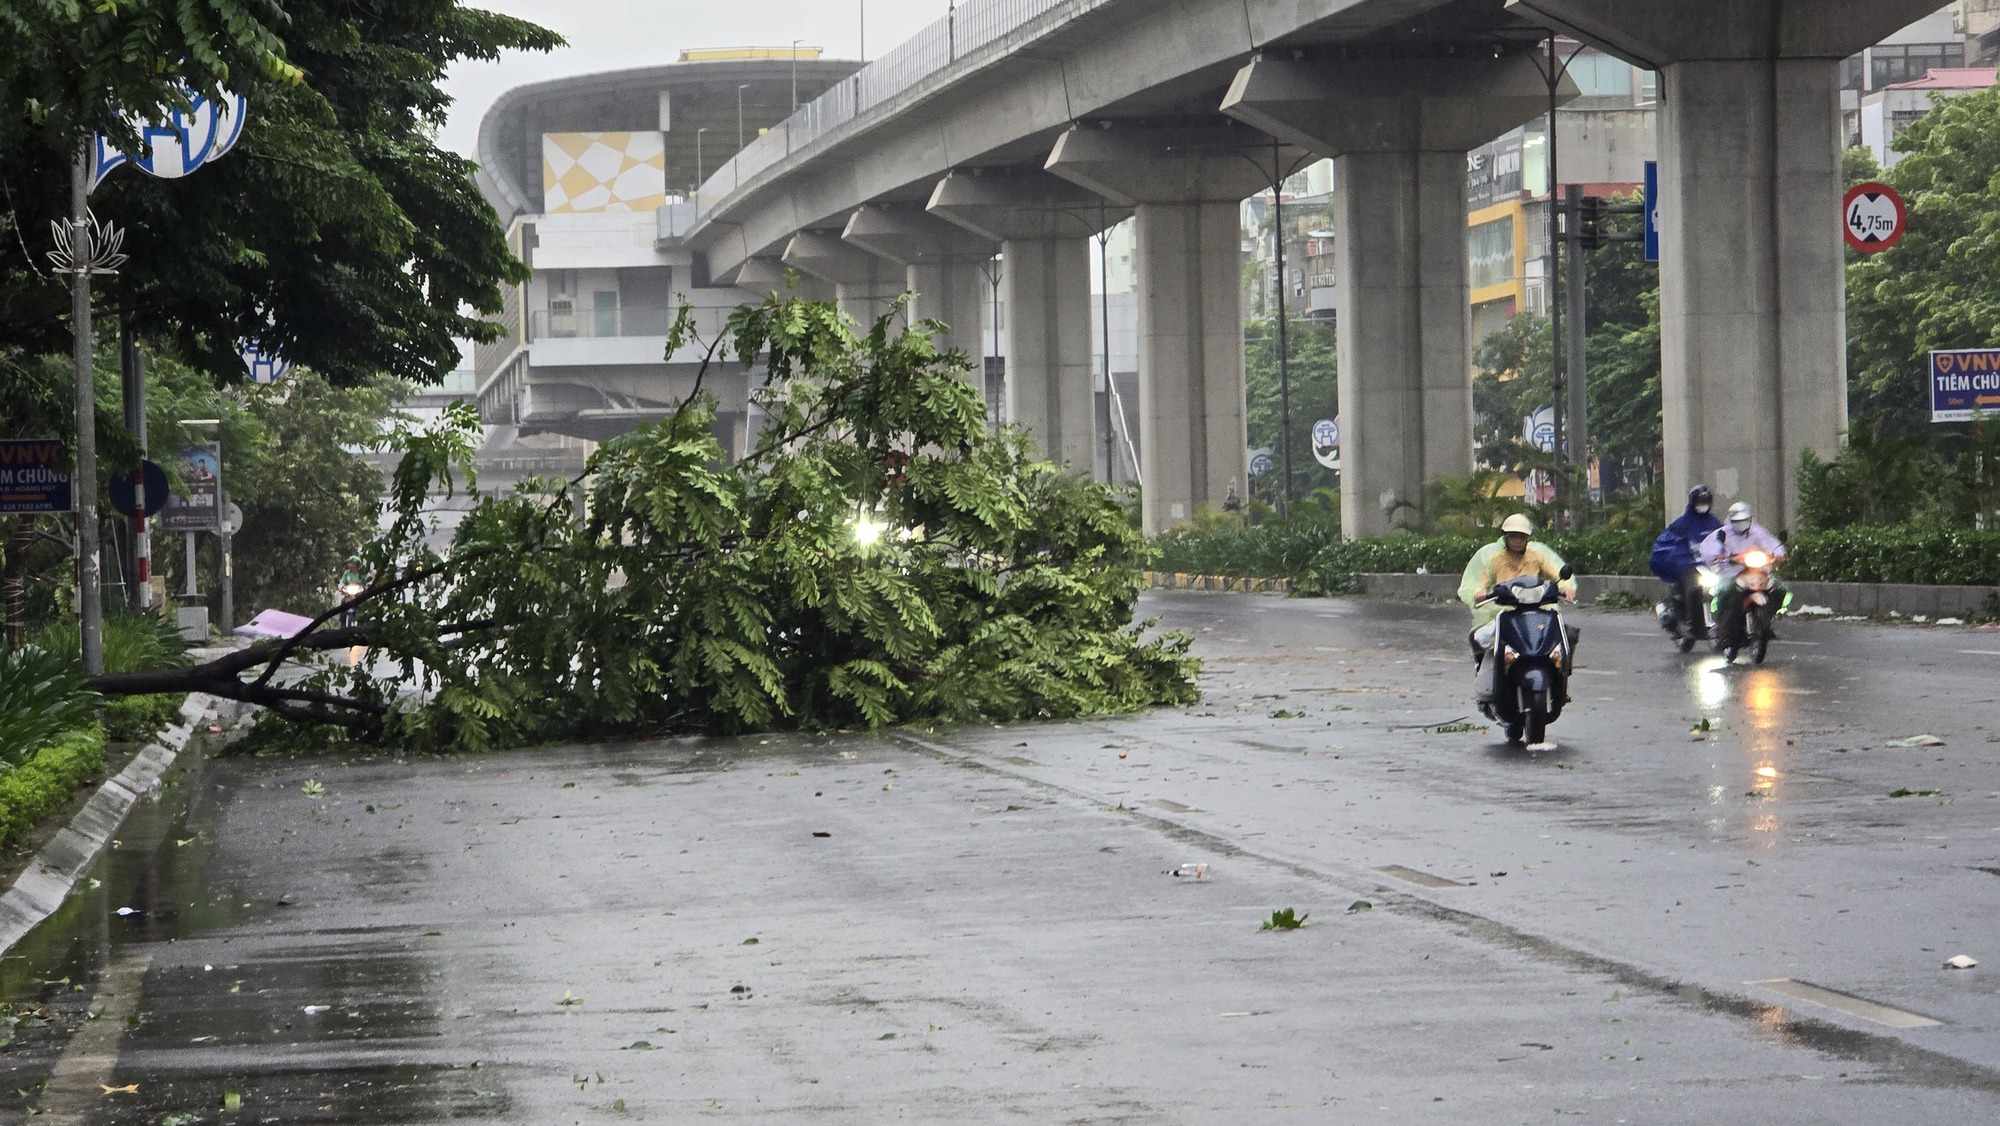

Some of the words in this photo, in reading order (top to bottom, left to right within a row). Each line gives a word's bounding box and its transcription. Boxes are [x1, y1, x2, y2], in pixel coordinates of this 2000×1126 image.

[1850, 204, 1893, 234] 4,75m
[1937, 373, 1970, 391] TIÊM
[17, 464, 68, 483] CHỦNG
